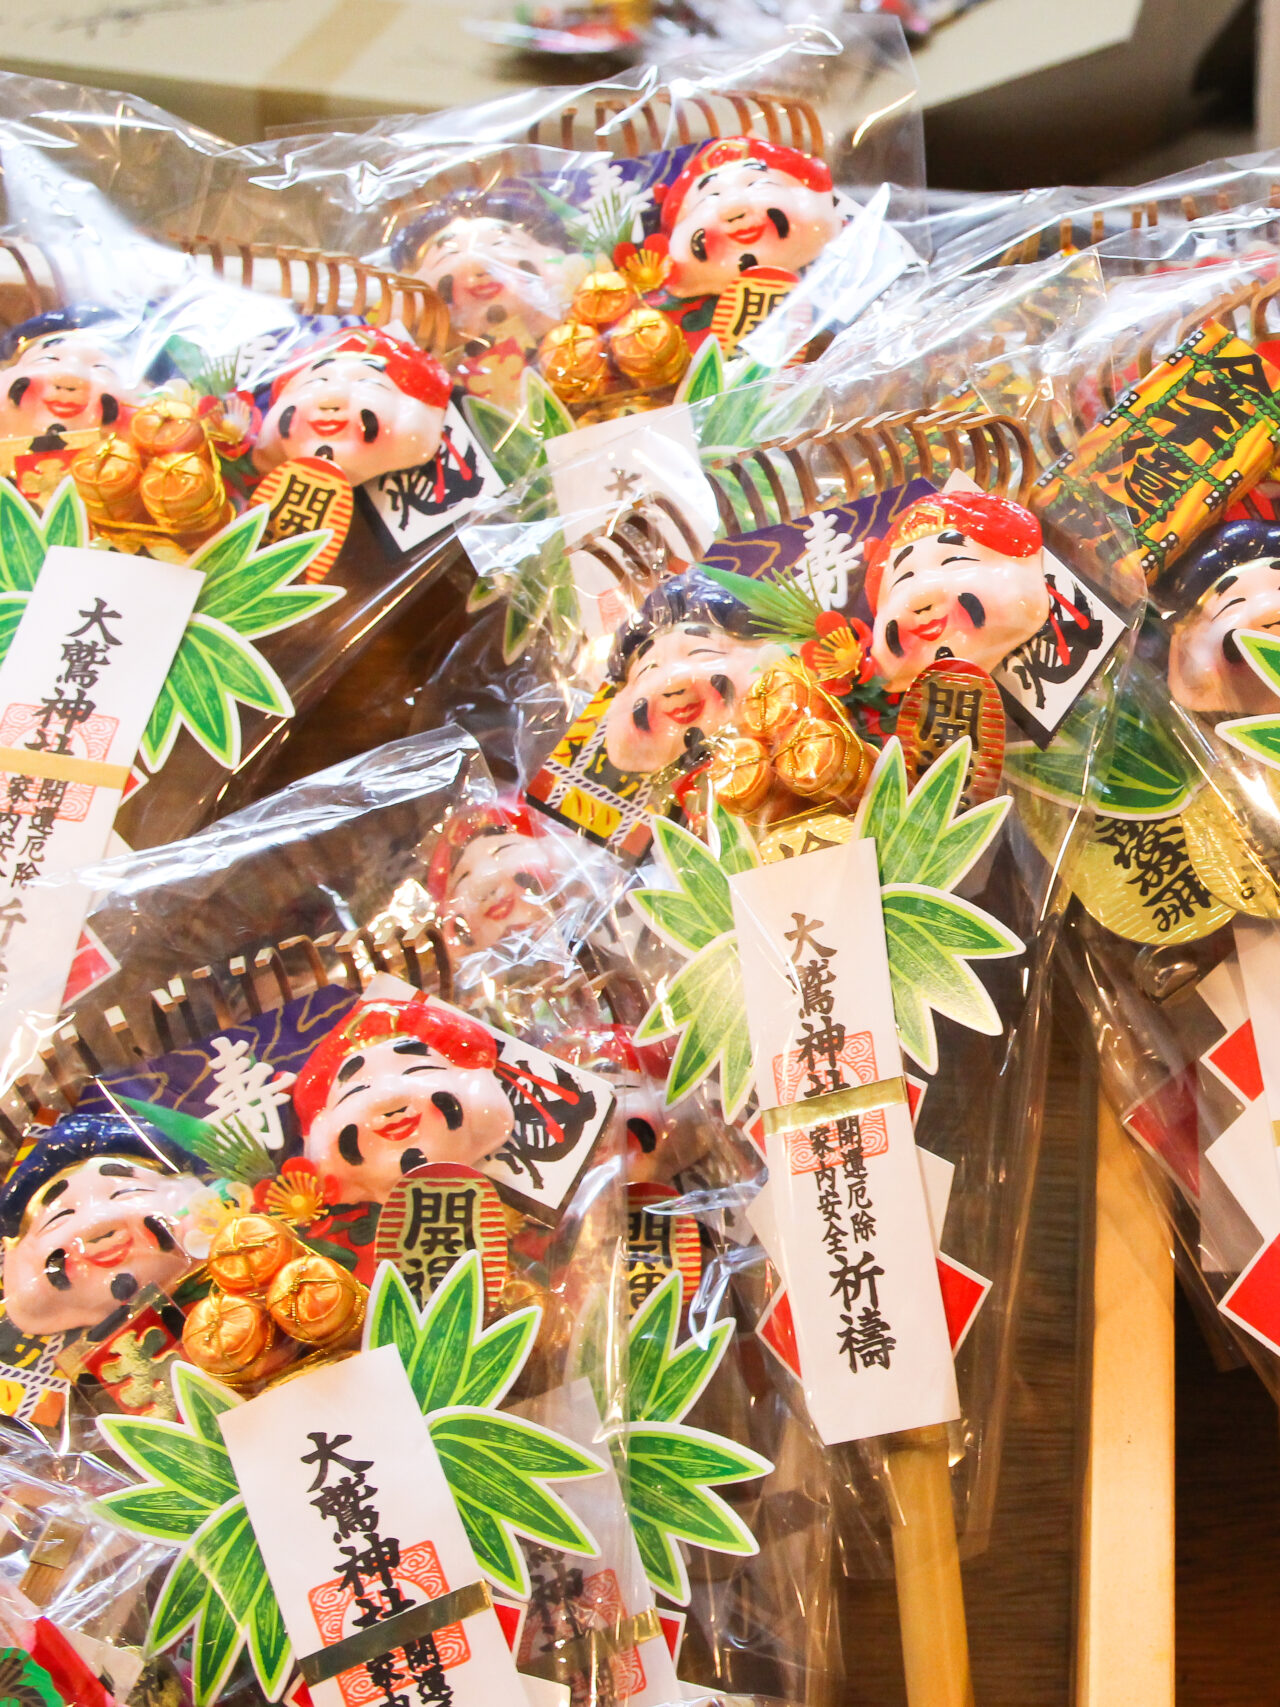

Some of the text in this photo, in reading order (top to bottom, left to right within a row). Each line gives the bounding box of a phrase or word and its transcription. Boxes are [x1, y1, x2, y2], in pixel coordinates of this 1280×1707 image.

[266, 474, 336, 544] 開
[809, 1125, 849, 1256] 家内安全
[836, 1115, 877, 1243] 開運厄除
